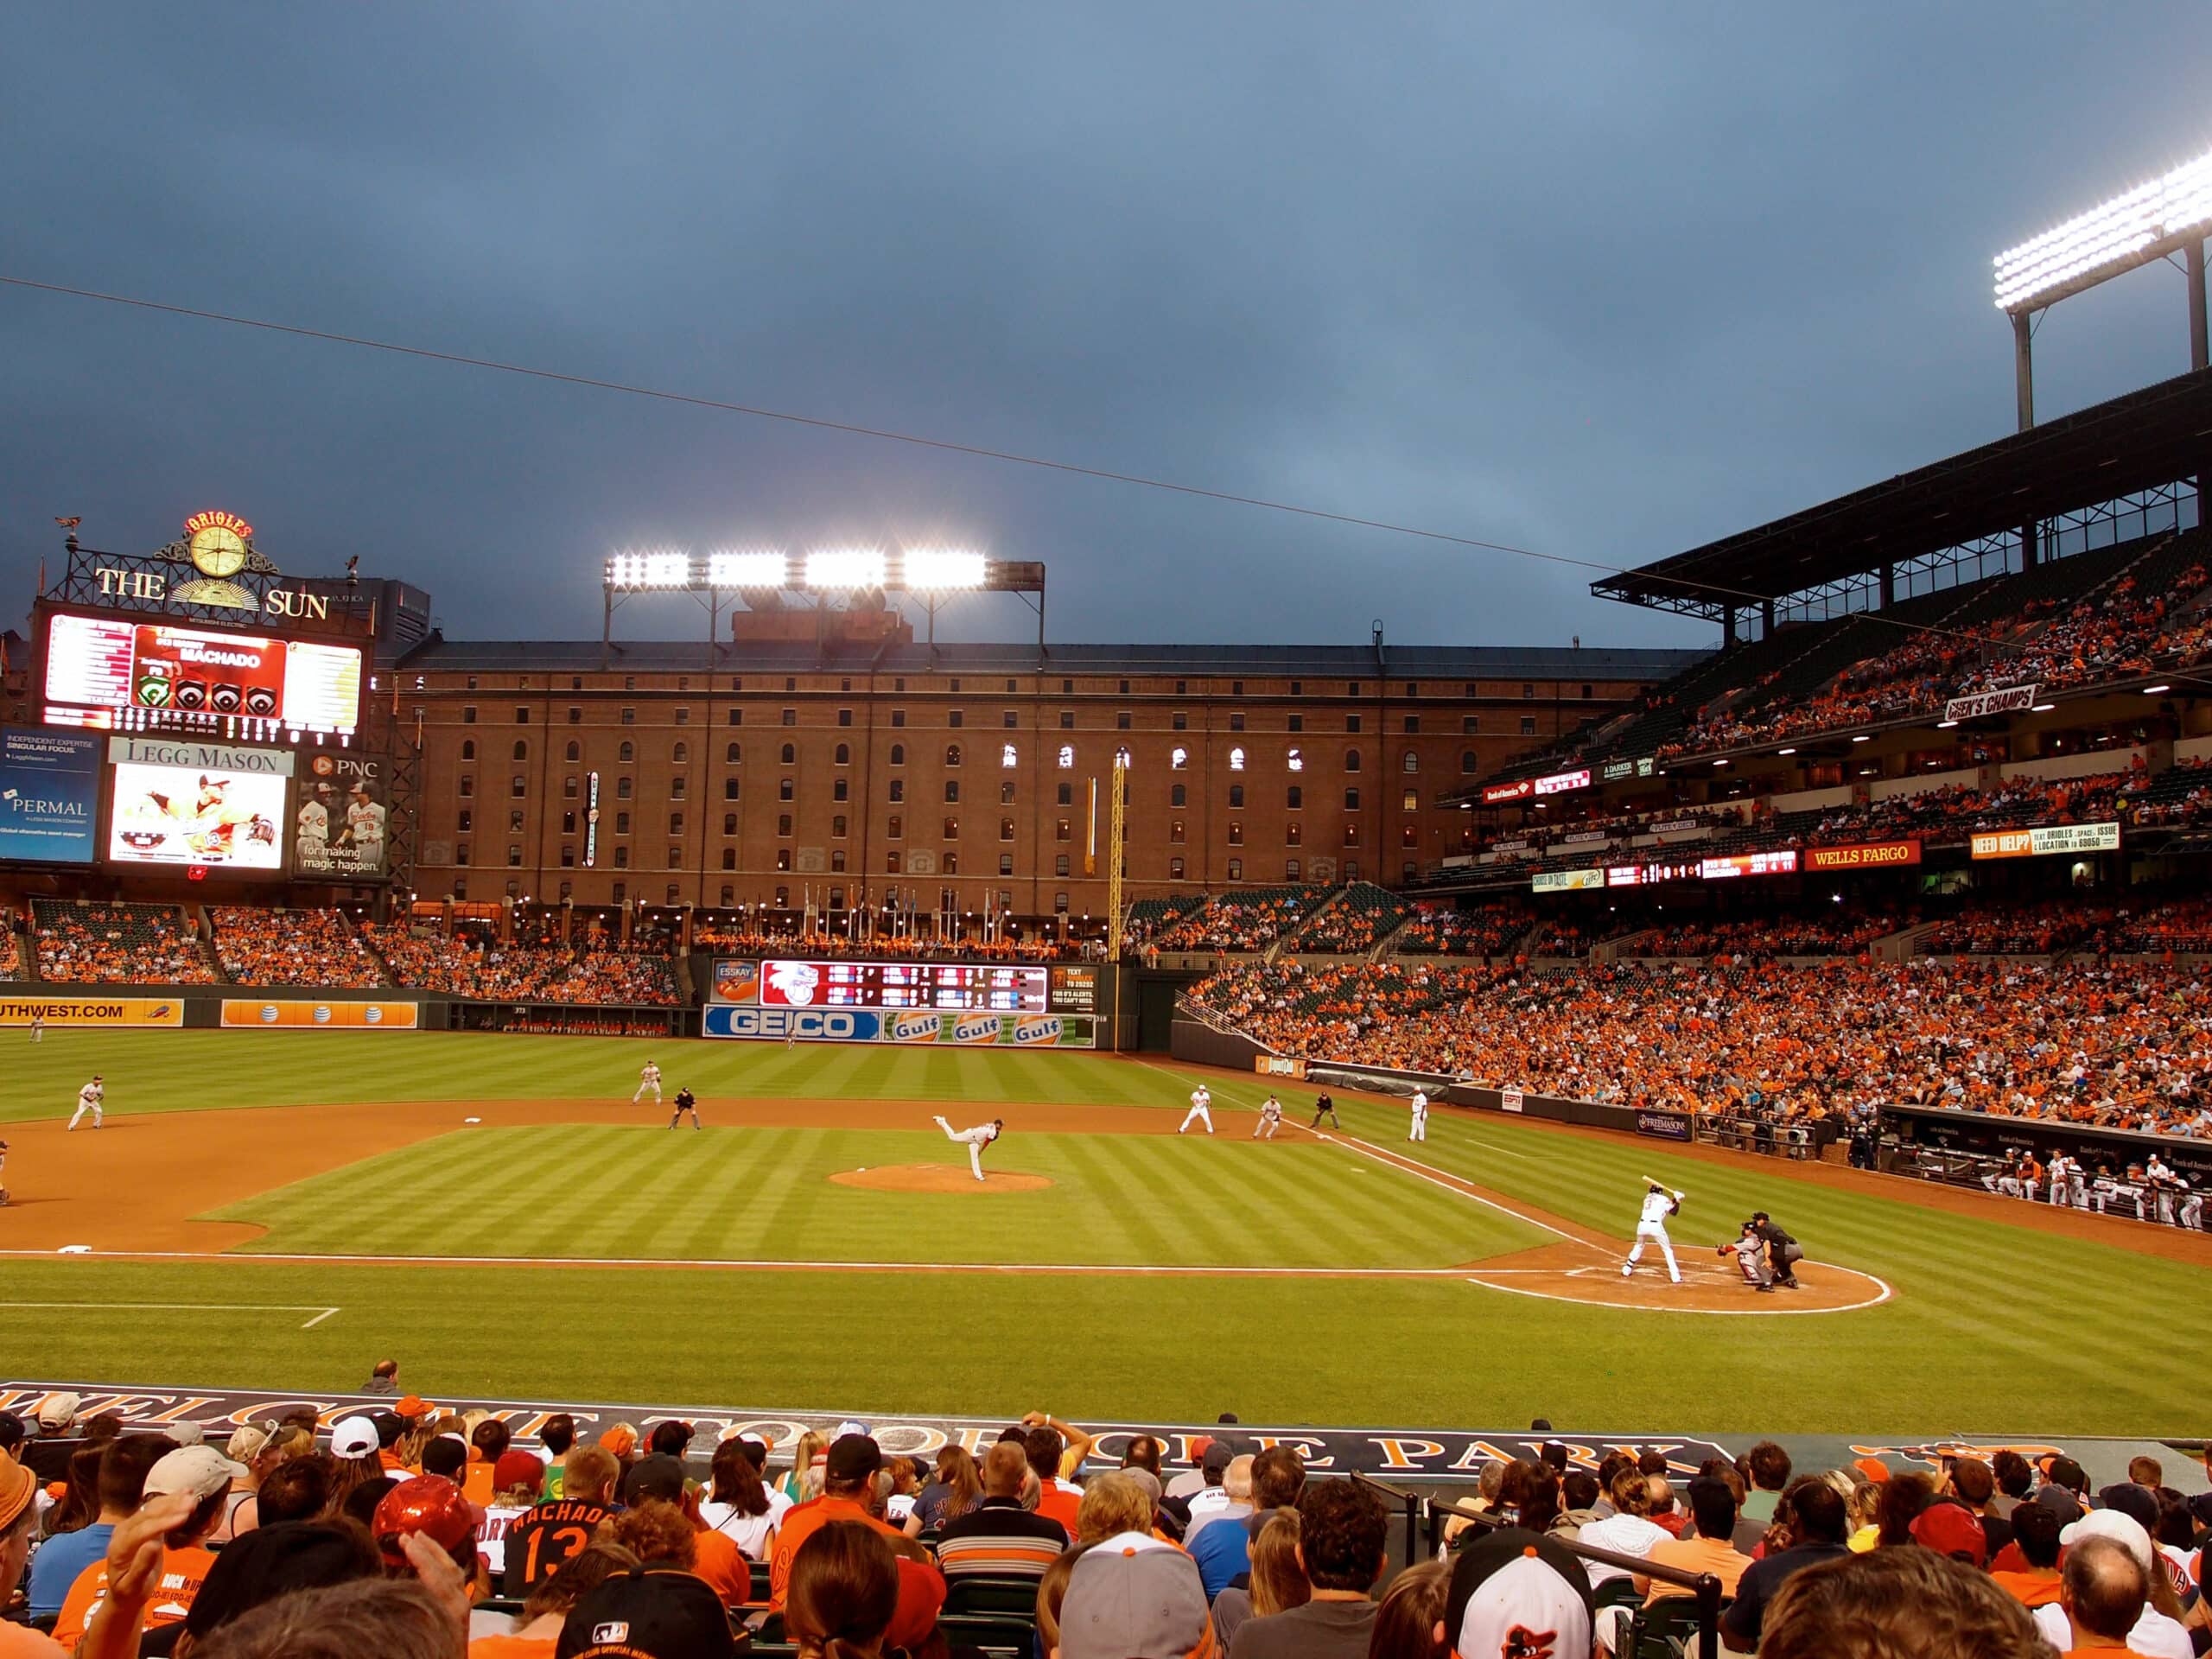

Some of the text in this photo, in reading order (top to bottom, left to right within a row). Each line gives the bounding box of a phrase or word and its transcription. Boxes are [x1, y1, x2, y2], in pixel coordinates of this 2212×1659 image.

[186, 511, 252, 538] ORIOLES
[96, 568, 329, 620] THE SUN
[180, 648, 261, 669] MACHADO
[1986, 690, 2032, 714] CHAMPS
[7, 742, 47, 752] SINGULAR
[127, 741, 277, 772] LEGG MASON
[336, 760, 378, 778] PNC
[13, 798, 88, 817] PERMAL
[2047, 829, 2073, 840] ORIOLES
[2097, 825, 2116, 836] ISSUE
[303, 846, 361, 859] for making
[1973, 834, 2030, 854] NEED HELP?
[2038, 840, 2069, 851] LOCATION
[303, 858, 378, 873] magic happen.
[1815, 846, 1909, 866] WELLS FARGO
[719, 966, 752, 977] ESSKAY
[729, 1009, 855, 1038] GEICO
[895, 1017, 939, 1038] Gulf
[955, 1019, 998, 1039] Gulf
[1014, 1020, 1059, 1041] Gulf
[1504, 1094, 1521, 1104] ESPN
[1646, 1117, 1686, 1131] FREEMASONS
[2171, 1158, 2185, 1166] Bank
[640, 1415, 811, 1462] TO
[868, 1424, 1336, 1467] OROLE
[1367, 1437, 1702, 1475] PARK
[476, 1517, 516, 1543] ORT
[524, 1526, 588, 1585] 13
